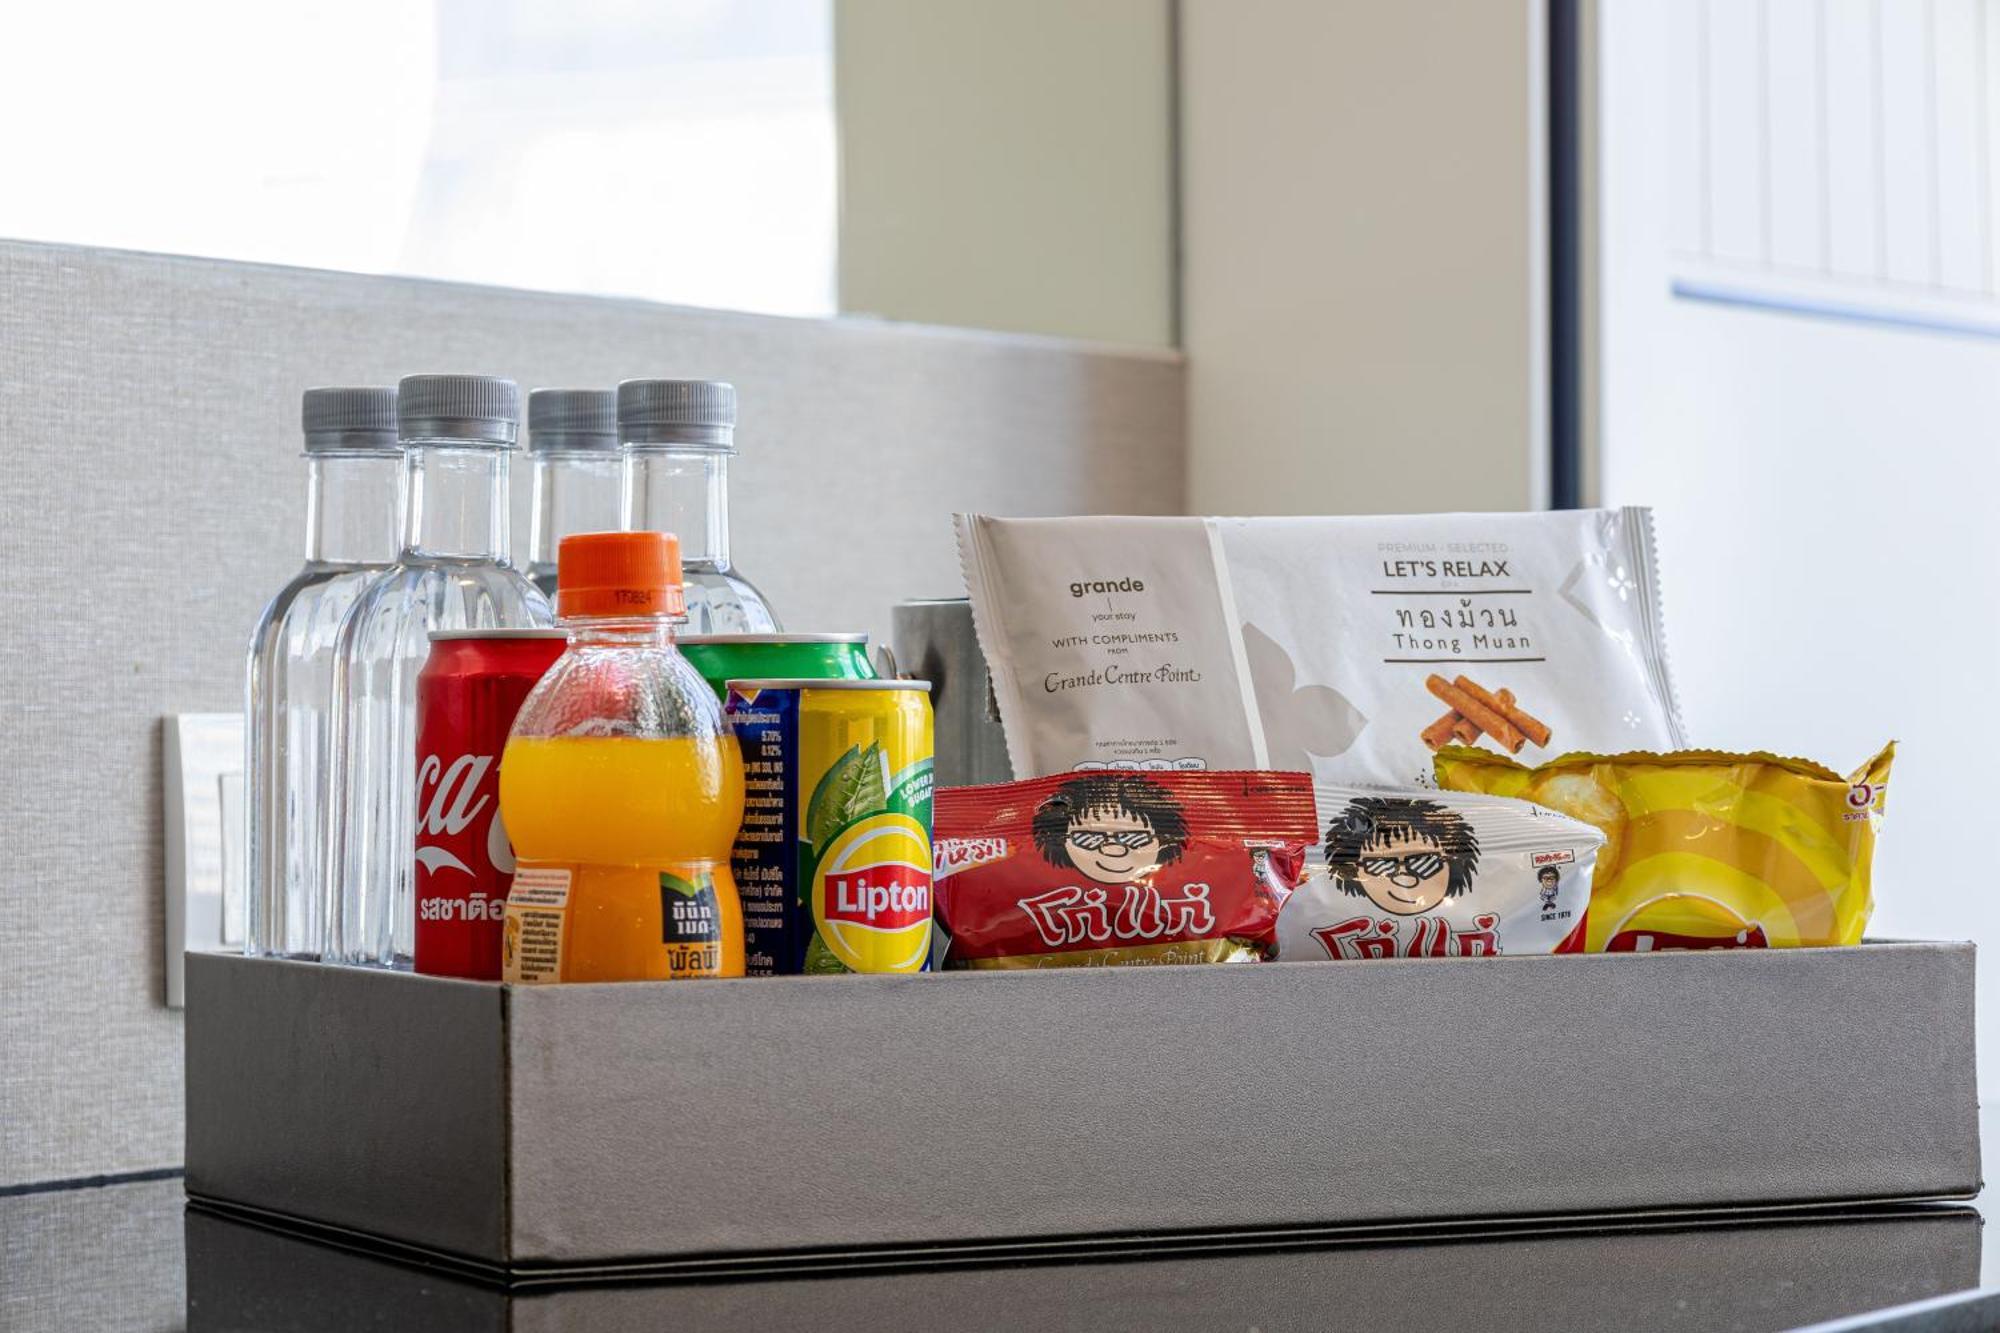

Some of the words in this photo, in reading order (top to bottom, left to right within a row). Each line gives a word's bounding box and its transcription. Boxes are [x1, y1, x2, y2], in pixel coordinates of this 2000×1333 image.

[1377, 543, 1436, 553] PREMIUM
[1447, 543, 1509, 553] SELECTED
[1383, 561, 1437, 577] LET'S
[1442, 561, 1511, 577] RELAX
[1070, 577, 1145, 598] grande
[1092, 613, 1114, 622] your
[1115, 611, 1137, 622] stay
[1396, 598, 1518, 629] ทองม้วน
[1052, 636, 1088, 649] WITH
[1092, 632, 1179, 645] COMPLIMENTS
[1392, 633, 1462, 654] Thong
[1473, 634, 1531, 649] Muan
[1044, 670, 1102, 693] Grande
[1104, 664, 1152, 684] Centre
[1154, 663, 1202, 682] Point
[837, 878, 929, 920] Lipton
